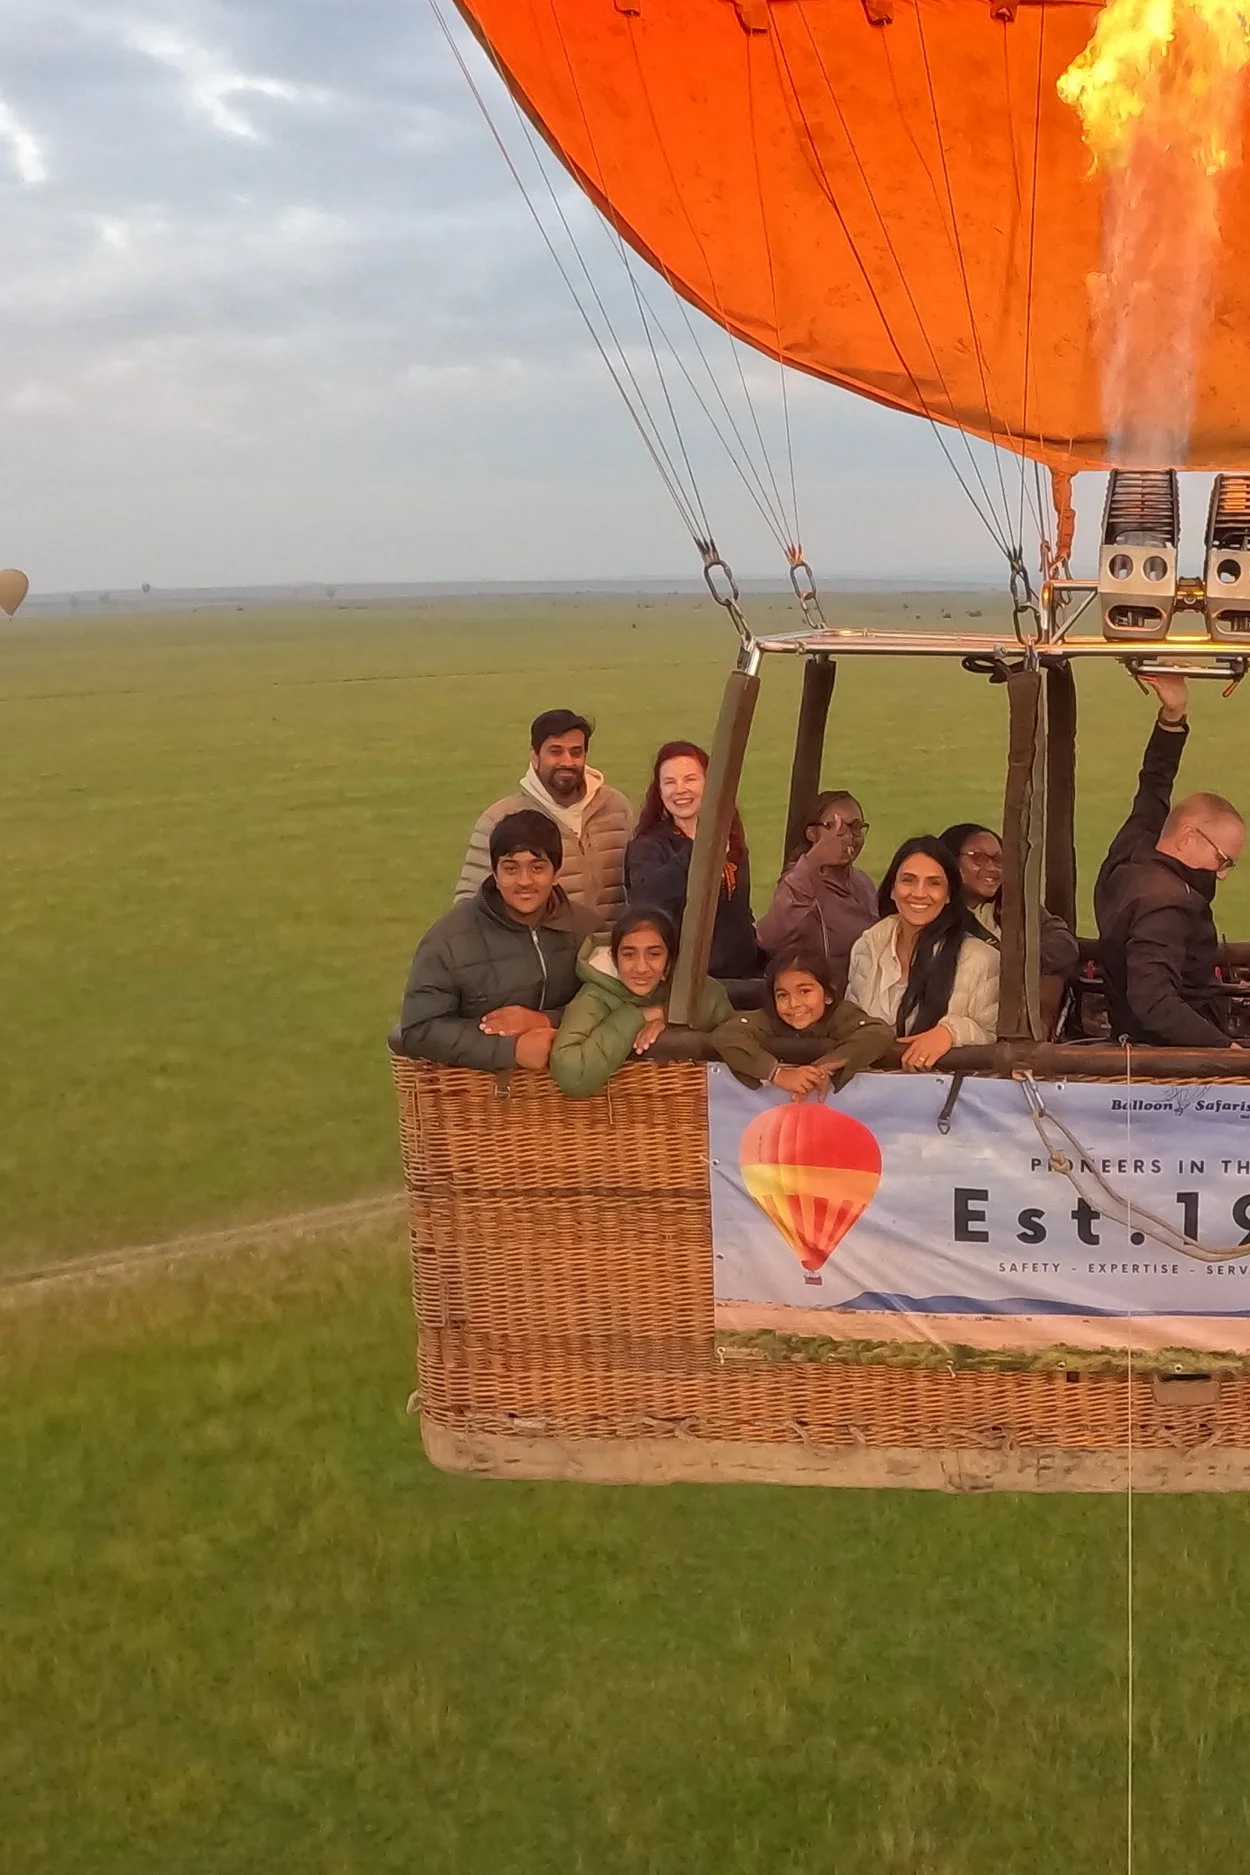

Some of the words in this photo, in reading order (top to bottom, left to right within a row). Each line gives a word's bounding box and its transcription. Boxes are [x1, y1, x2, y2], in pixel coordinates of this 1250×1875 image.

[1110, 1099, 1173, 1111] Balloon
[1179, 1160, 1205, 1174] IN
[999, 1262, 1061, 1273] SAFETY
[1088, 1263, 1179, 1275] EXPERTISE
